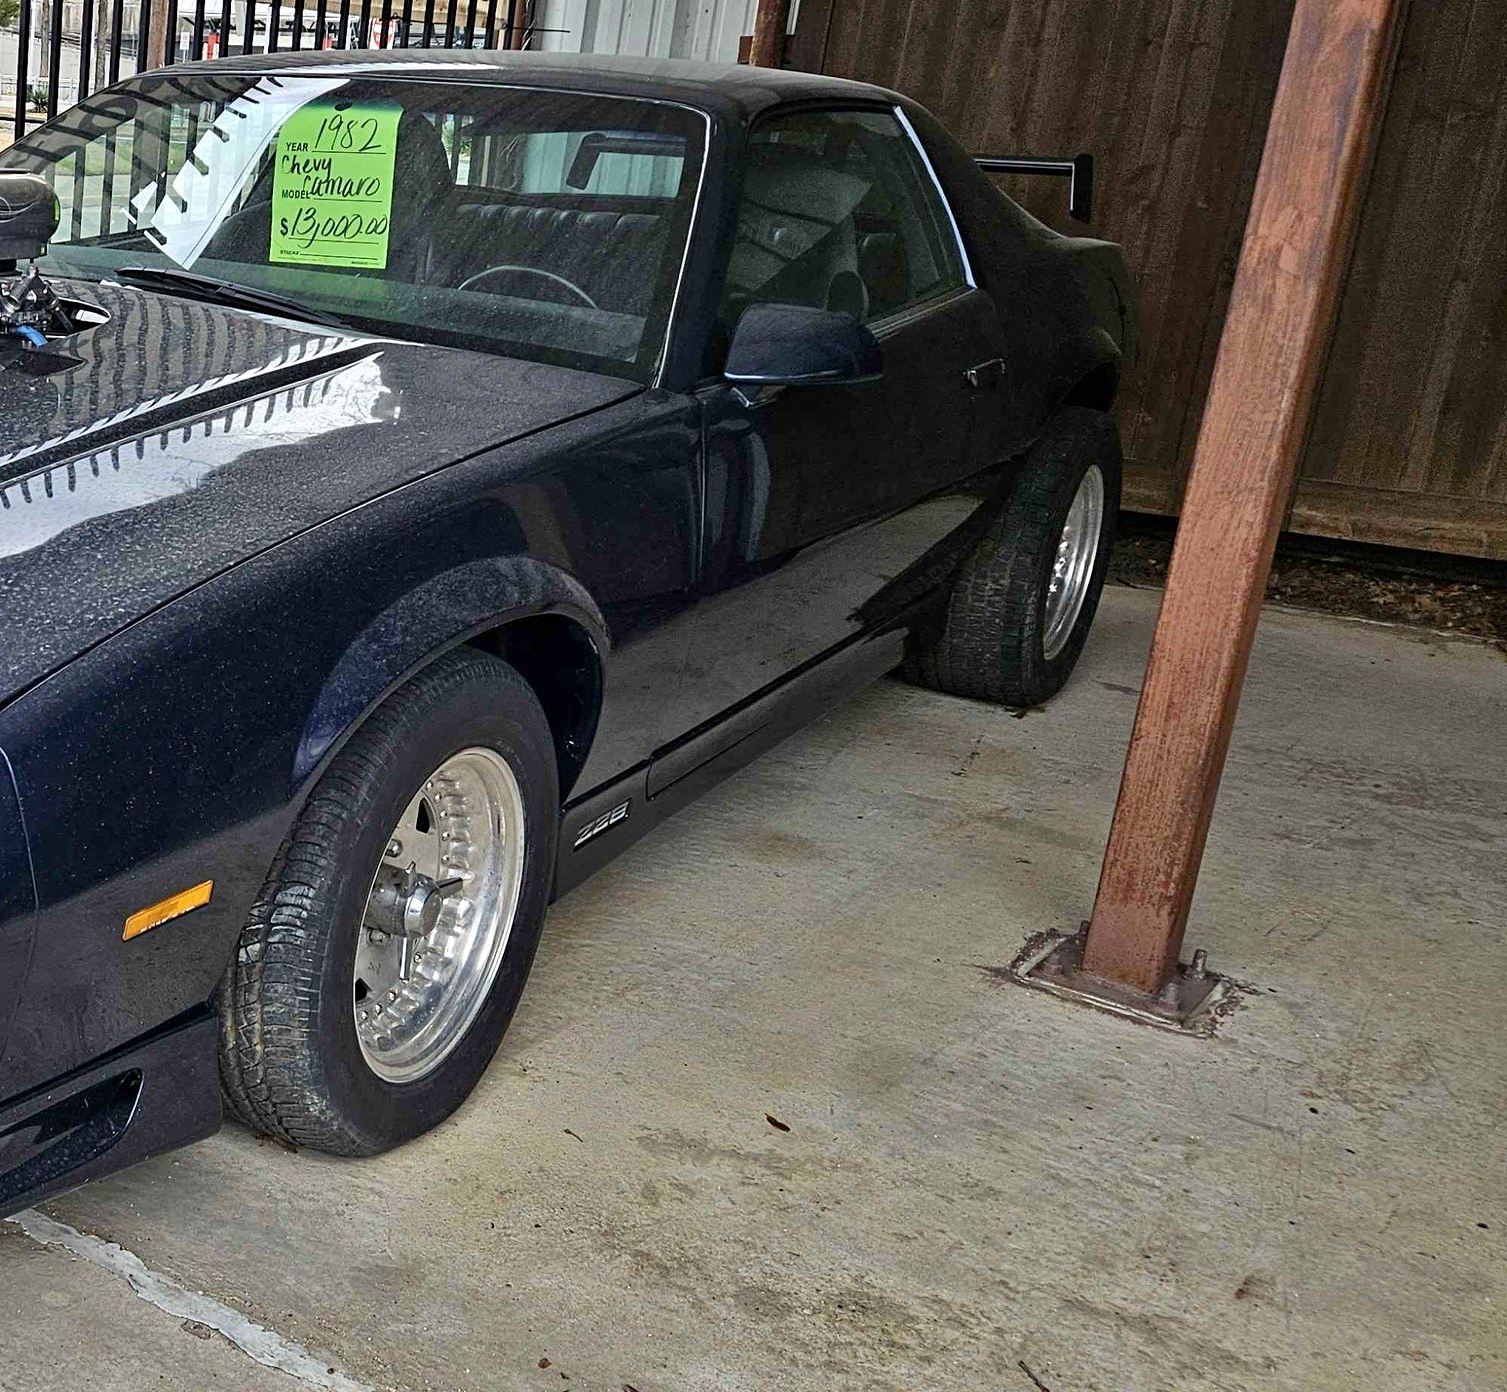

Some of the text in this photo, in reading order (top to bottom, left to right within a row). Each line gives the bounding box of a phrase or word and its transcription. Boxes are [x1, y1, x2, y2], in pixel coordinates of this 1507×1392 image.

[286, 114, 381, 152] YEAR 1982
[282, 155, 331, 180] Chevy
[282, 190, 310, 199] MODEL
